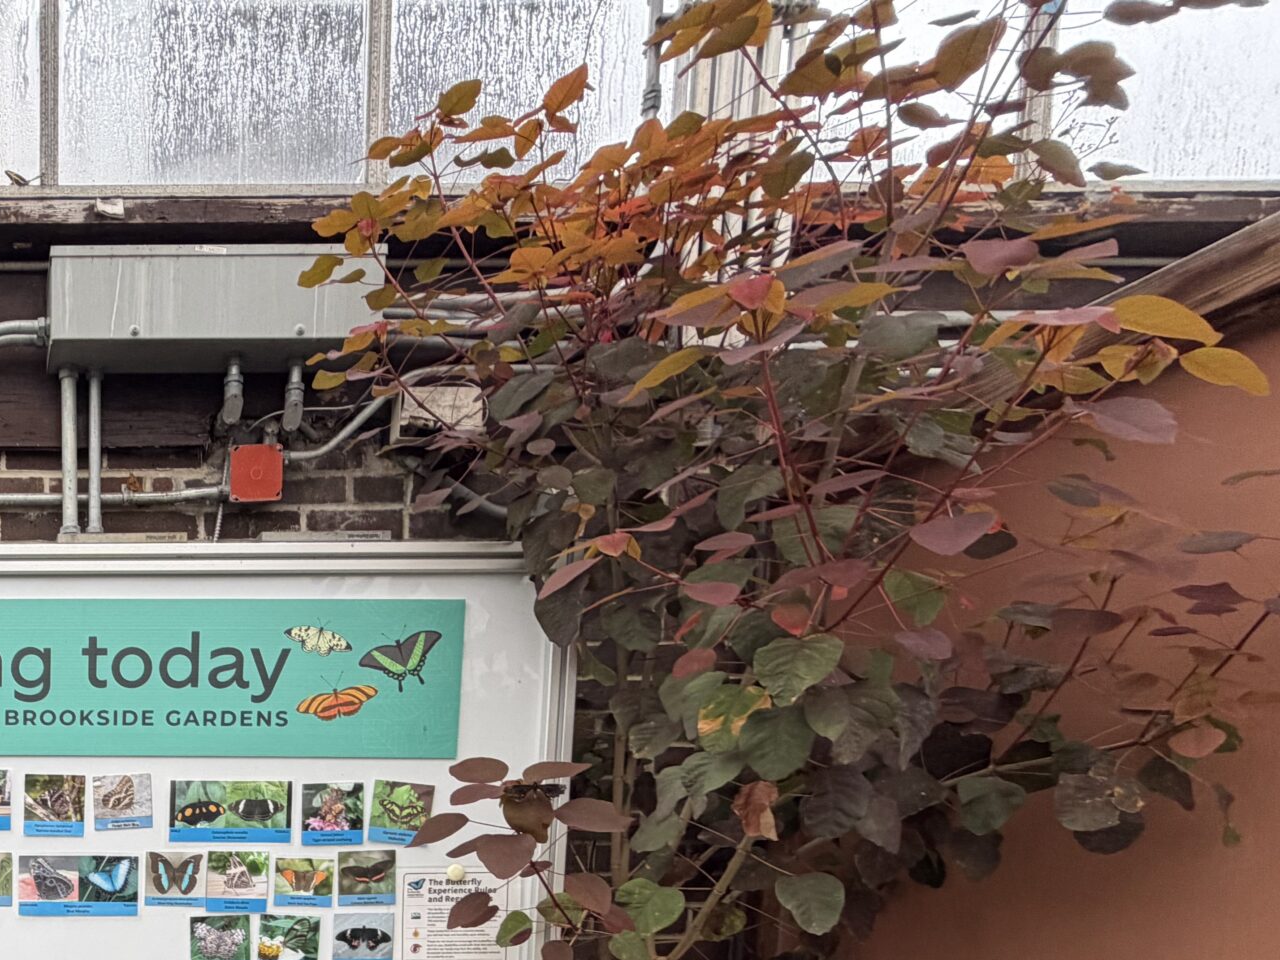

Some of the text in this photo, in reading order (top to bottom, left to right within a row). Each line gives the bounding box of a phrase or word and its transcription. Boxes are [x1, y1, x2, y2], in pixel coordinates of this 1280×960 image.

[81, 631, 292, 704] today
[4, 709, 155, 726] BROOKSIDE
[165, 709, 289, 727] GARDENS
[428, 878, 482, 887] The Butterfly
[428, 887, 473, 896] Experience
